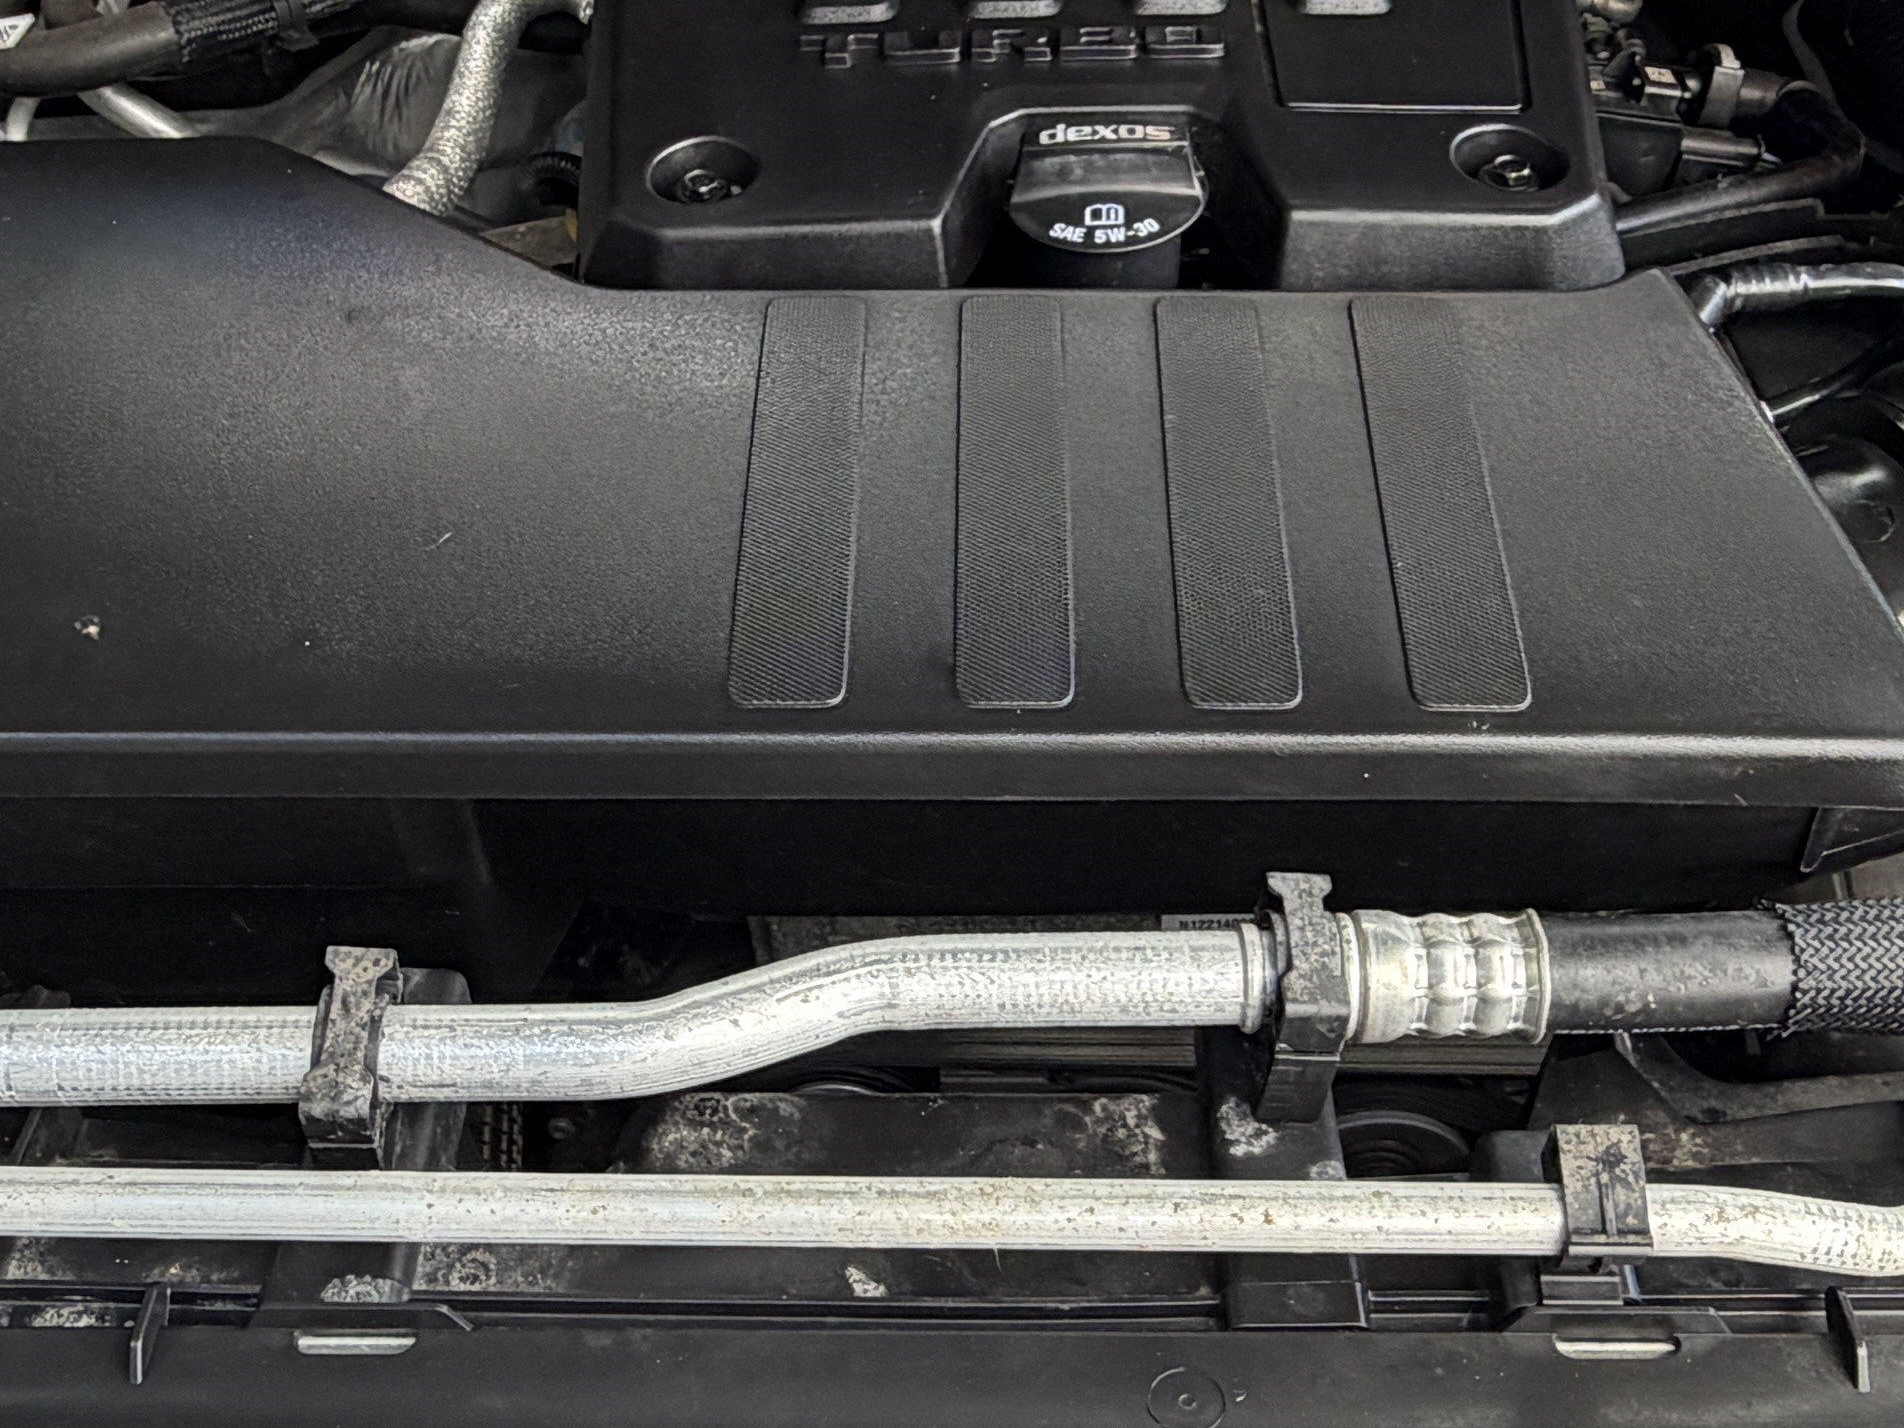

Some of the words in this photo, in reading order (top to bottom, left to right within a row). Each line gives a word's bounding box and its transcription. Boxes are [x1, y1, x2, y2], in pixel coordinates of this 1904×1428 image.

[799, 25, 1226, 69] TURBO
[1039, 123, 1175, 145] dexos
[1049, 223, 1087, 243] SAE
[1094, 218, 1161, 244] 5W-30
